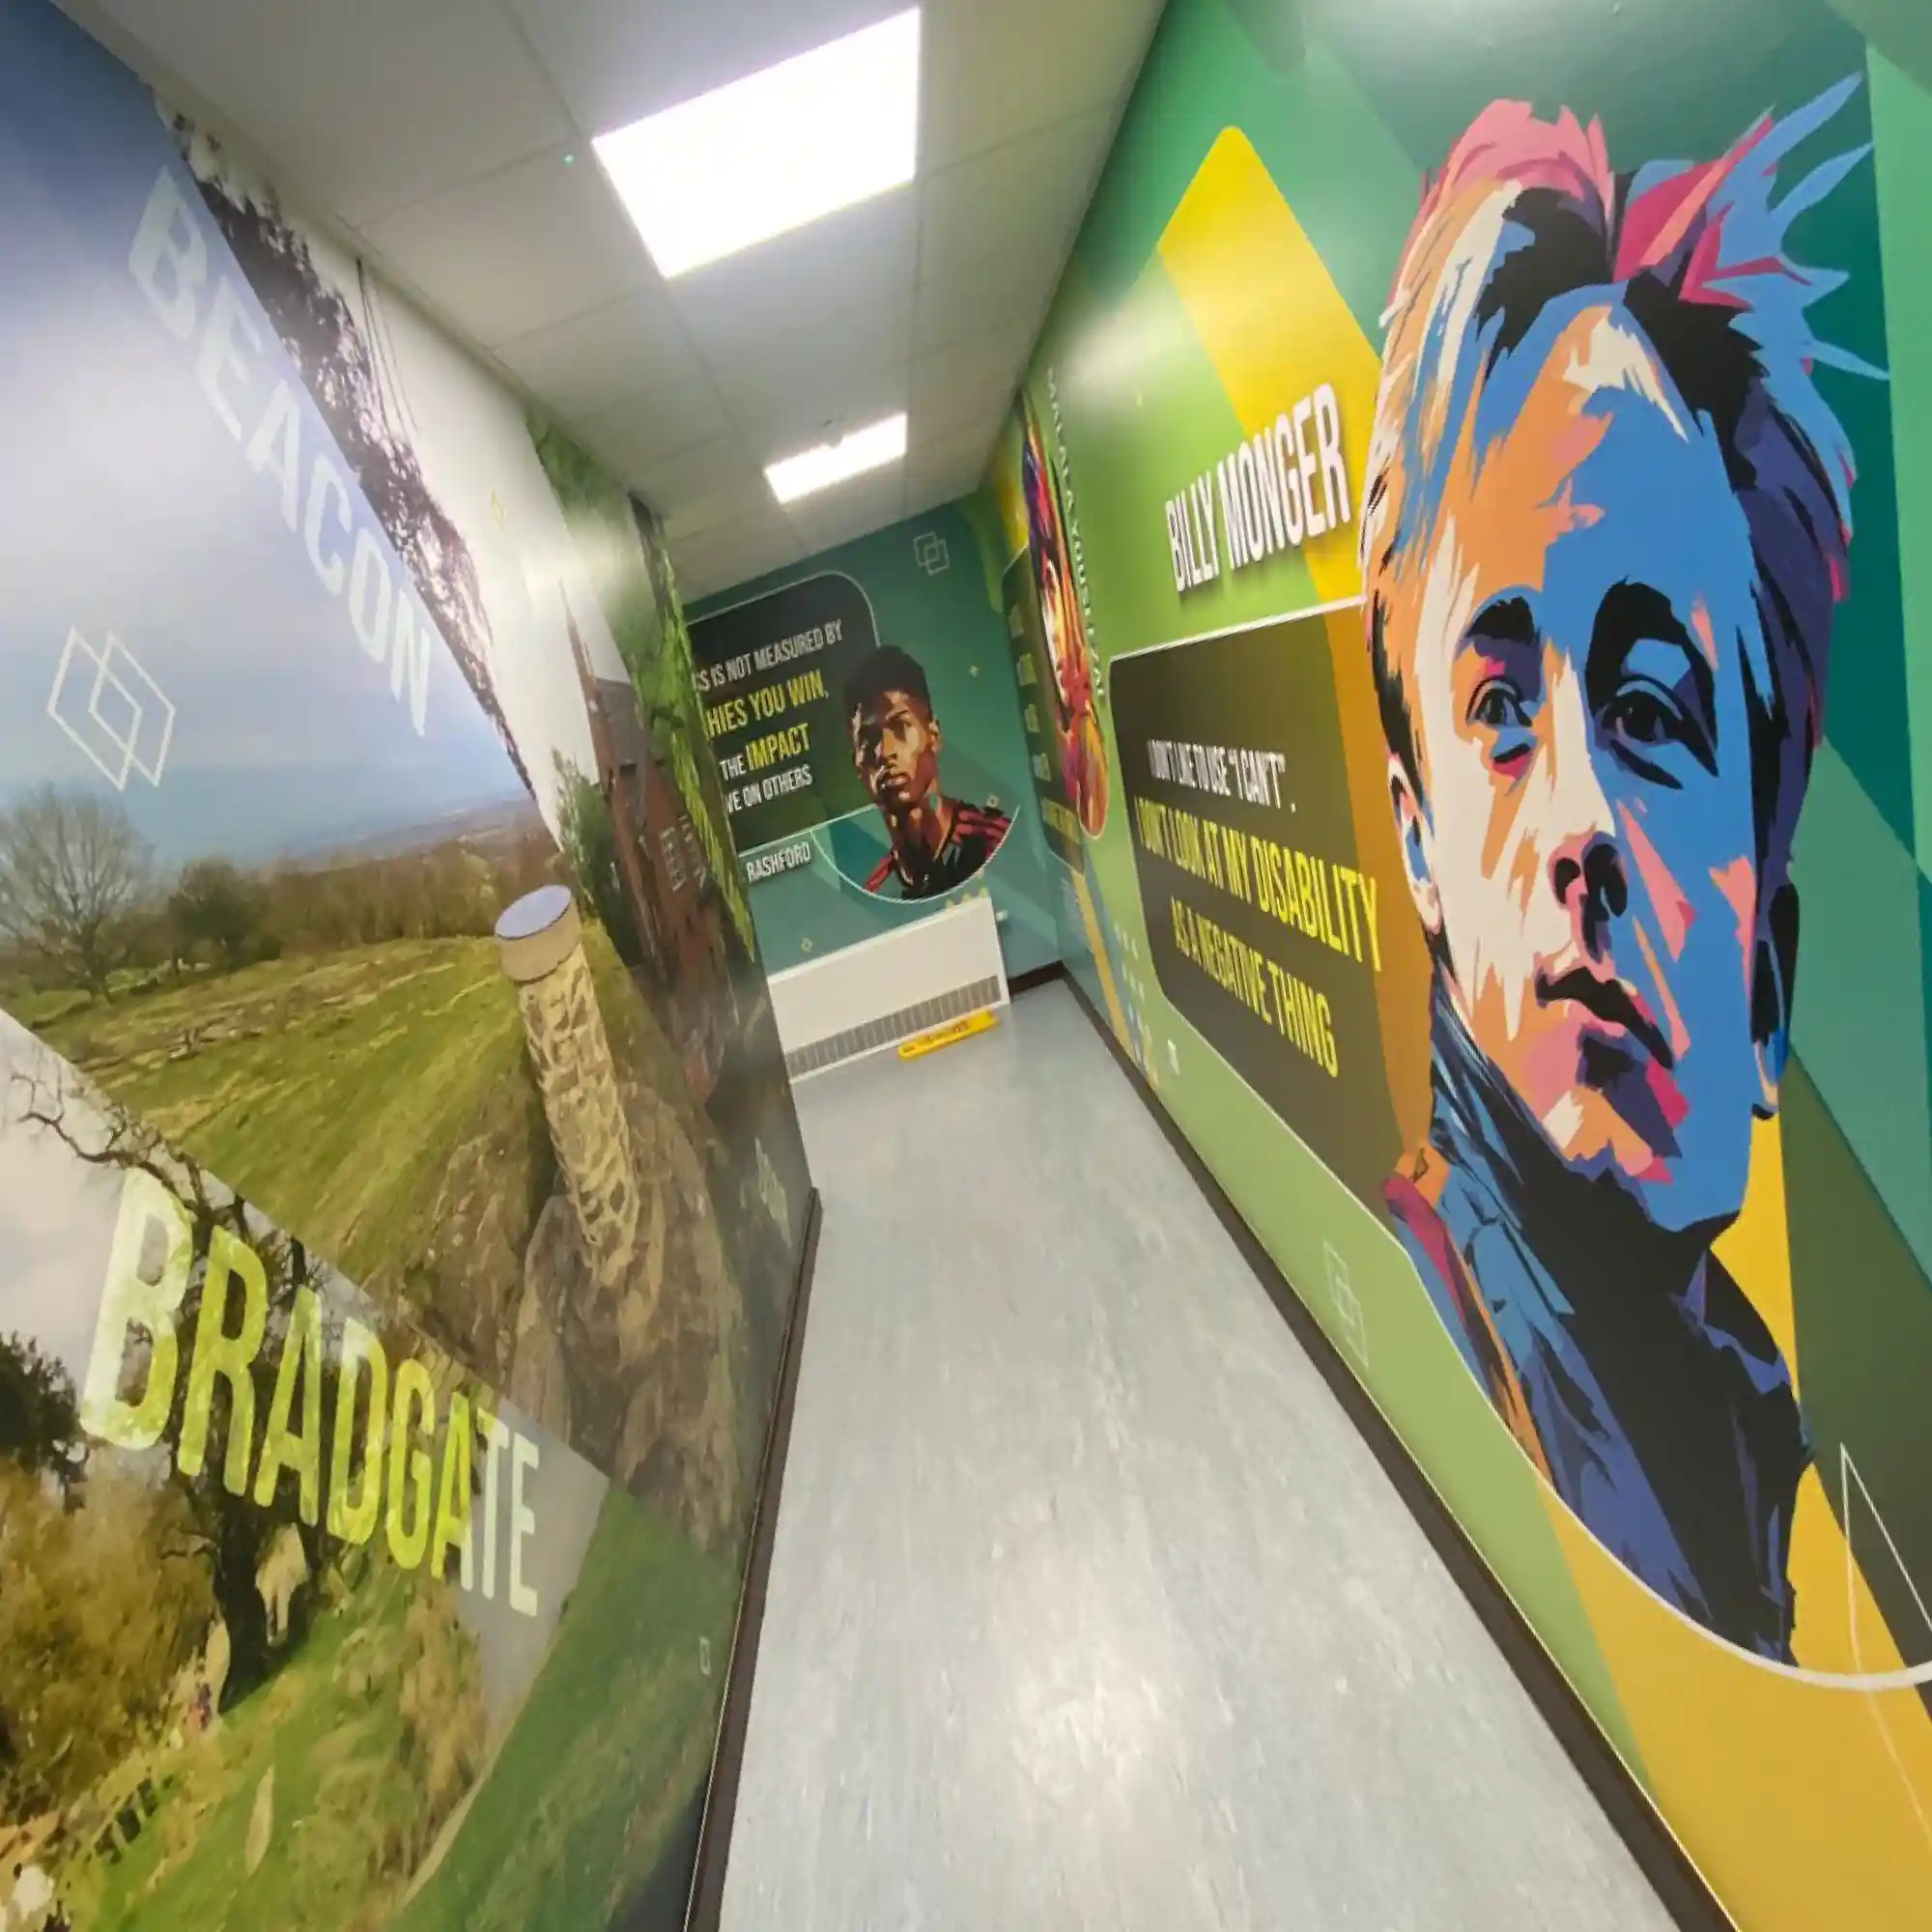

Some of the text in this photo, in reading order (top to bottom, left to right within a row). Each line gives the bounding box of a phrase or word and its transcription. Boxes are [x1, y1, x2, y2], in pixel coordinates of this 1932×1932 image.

[128, 165, 431, 738] BEACON
[1165, 383, 1350, 592] BILLY MONGER
[706, 668, 829, 739] HIES YOU WIN,
[710, 663, 725, 688] IS
[725, 653, 752, 683] NOT
[753, 627, 824, 671] MEASURED
[825, 618, 843, 645] BY
[719, 723, 810, 781] THE IMPACT
[742, 782, 762, 808] ON
[762, 763, 813, 801] OTHERS
[746, 841, 811, 883] RASHFORD
[1202, 818, 1224, 890] AT
[1221, 826, 1252, 904] MY
[1250, 835, 1382, 972] DISABILITY
[1195, 912, 1273, 1026] NEGATIVE
[1266, 958, 1339, 1078] THING
[79, 1167, 539, 1617] BRADGATE
